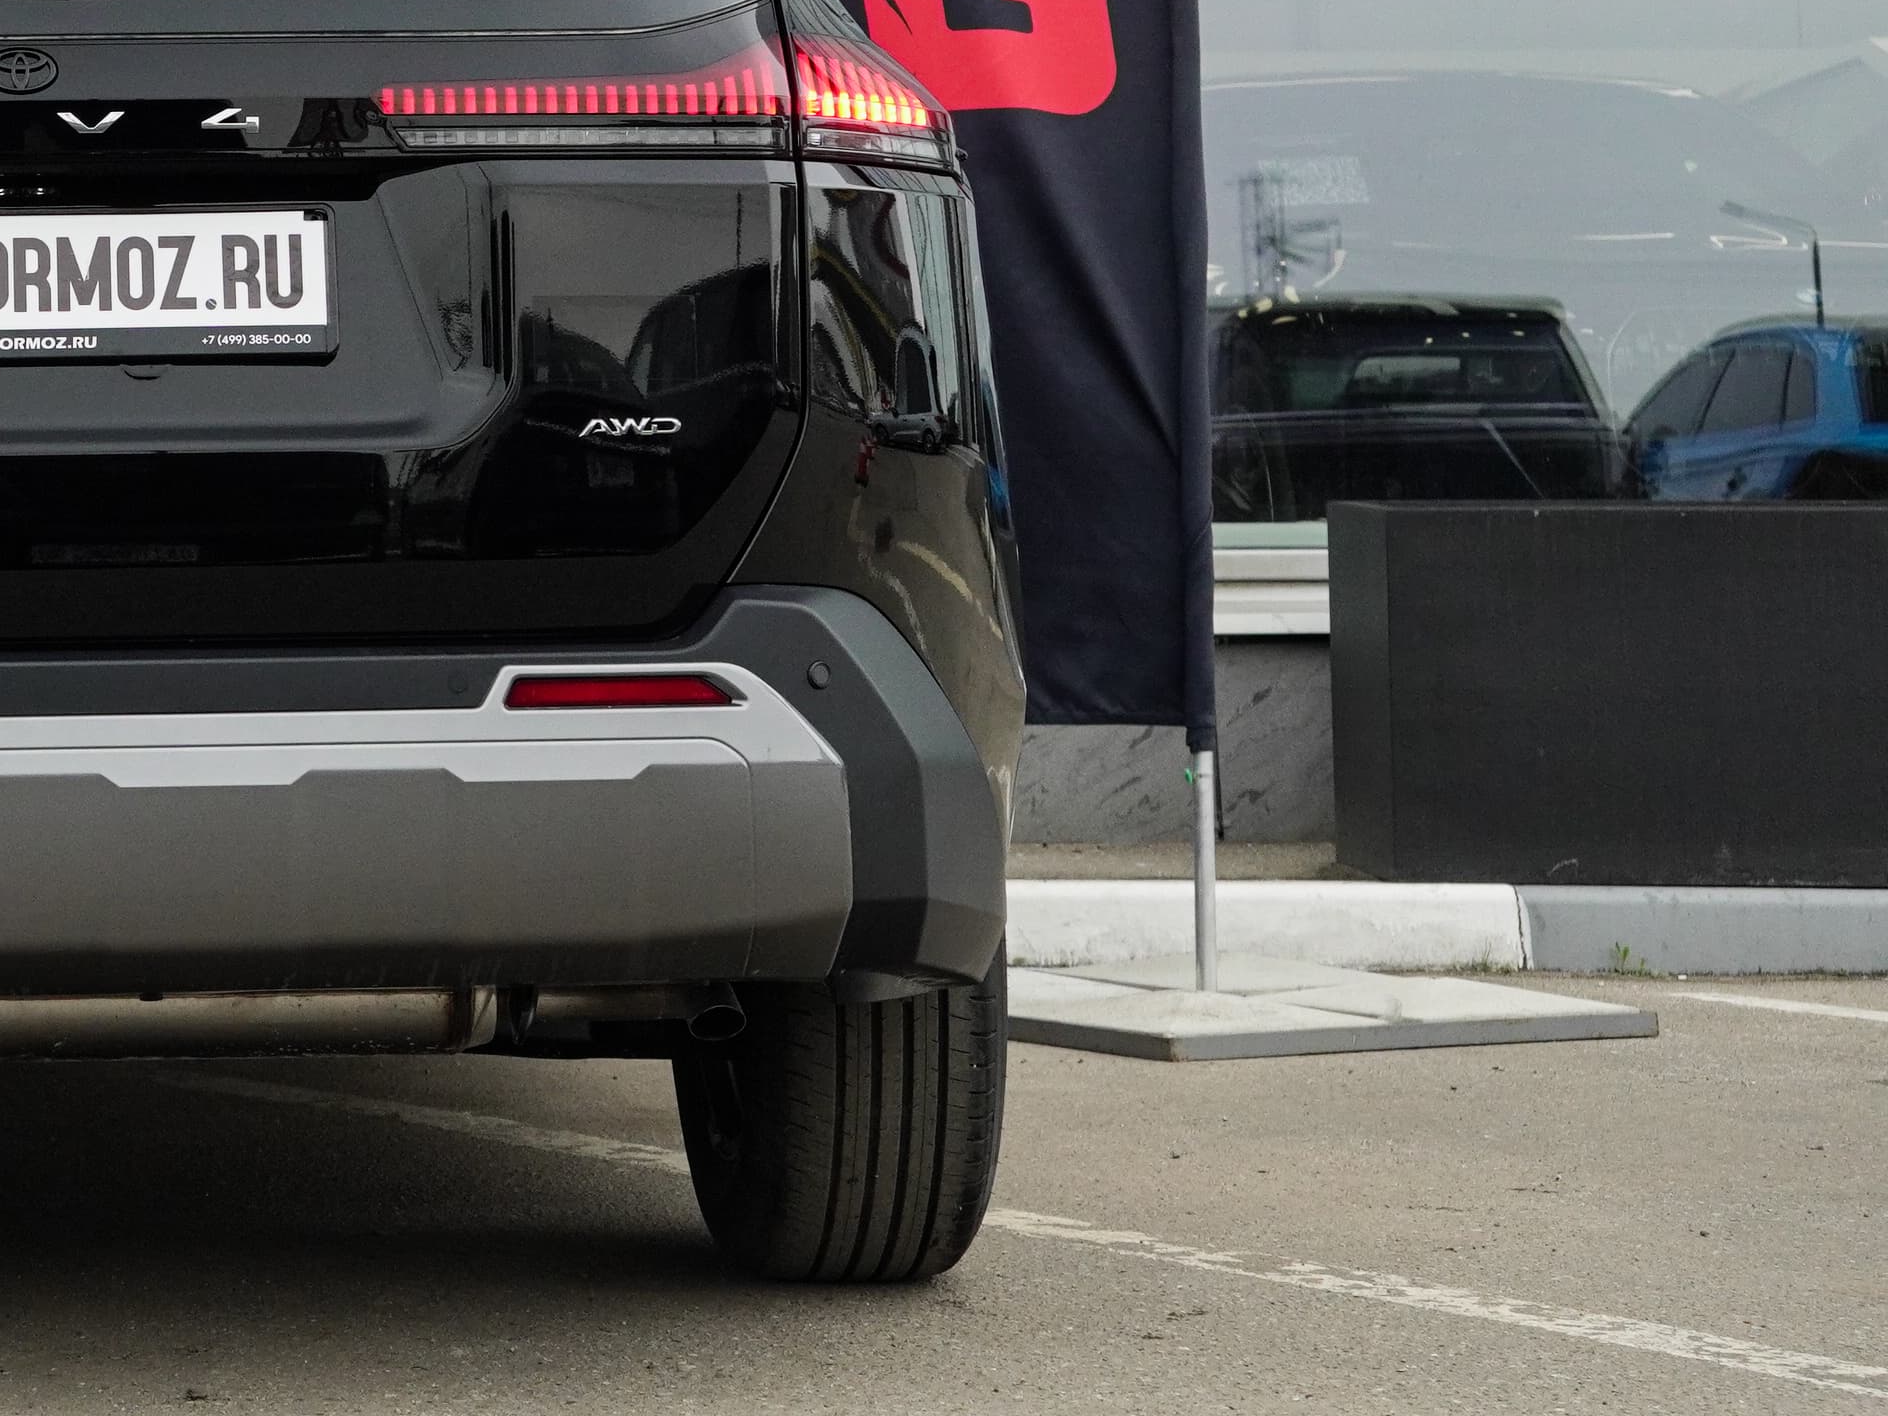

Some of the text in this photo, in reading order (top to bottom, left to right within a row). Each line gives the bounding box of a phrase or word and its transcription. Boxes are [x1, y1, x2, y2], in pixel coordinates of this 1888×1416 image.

[201, 333, 312, 347] +7 (499) 385-00-00
[578, 416, 682, 437] AWD
